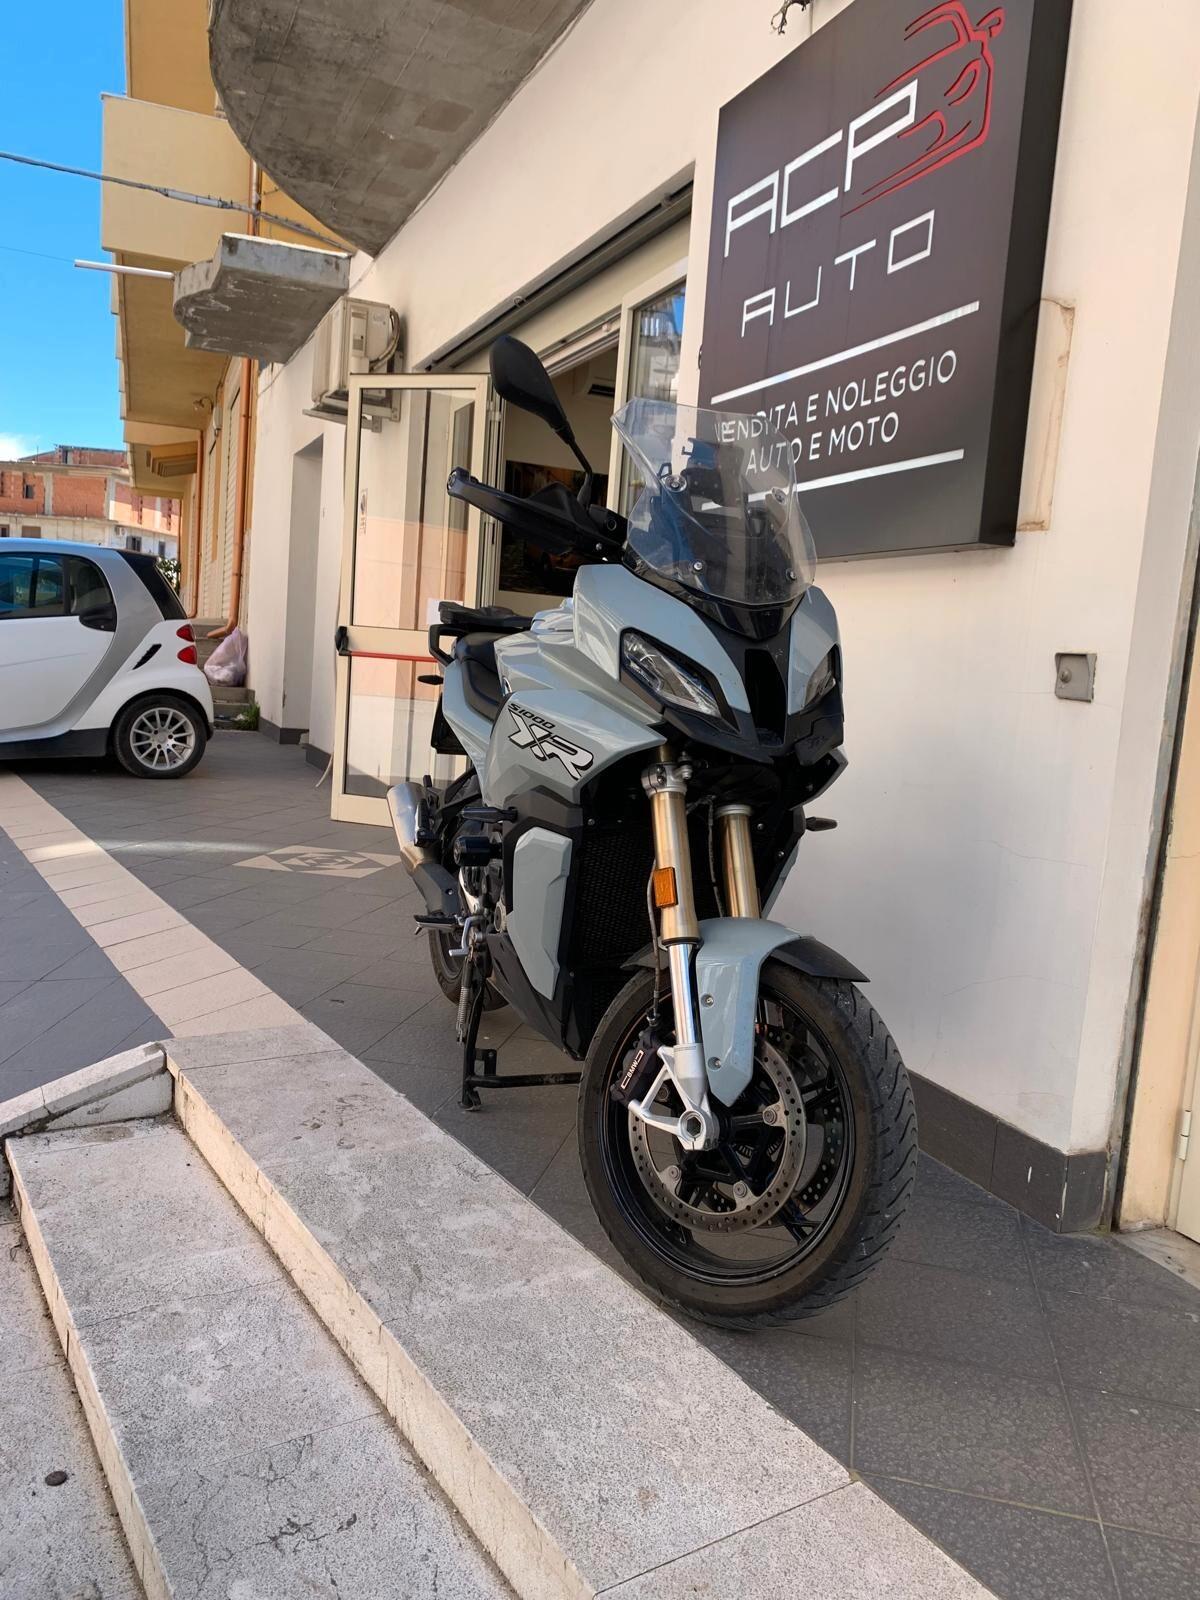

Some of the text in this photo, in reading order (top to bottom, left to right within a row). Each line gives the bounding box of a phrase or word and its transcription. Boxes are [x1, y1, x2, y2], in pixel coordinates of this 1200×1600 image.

[724, 78, 918, 258] ACP
[741, 209, 935, 338] AUTO
[714, 350, 957, 443] VENDITA E NOLEGGIO
[745, 411, 899, 476] AUTO E MOTO
[508, 703, 555, 729] S1000
[508, 708, 594, 781] XR
